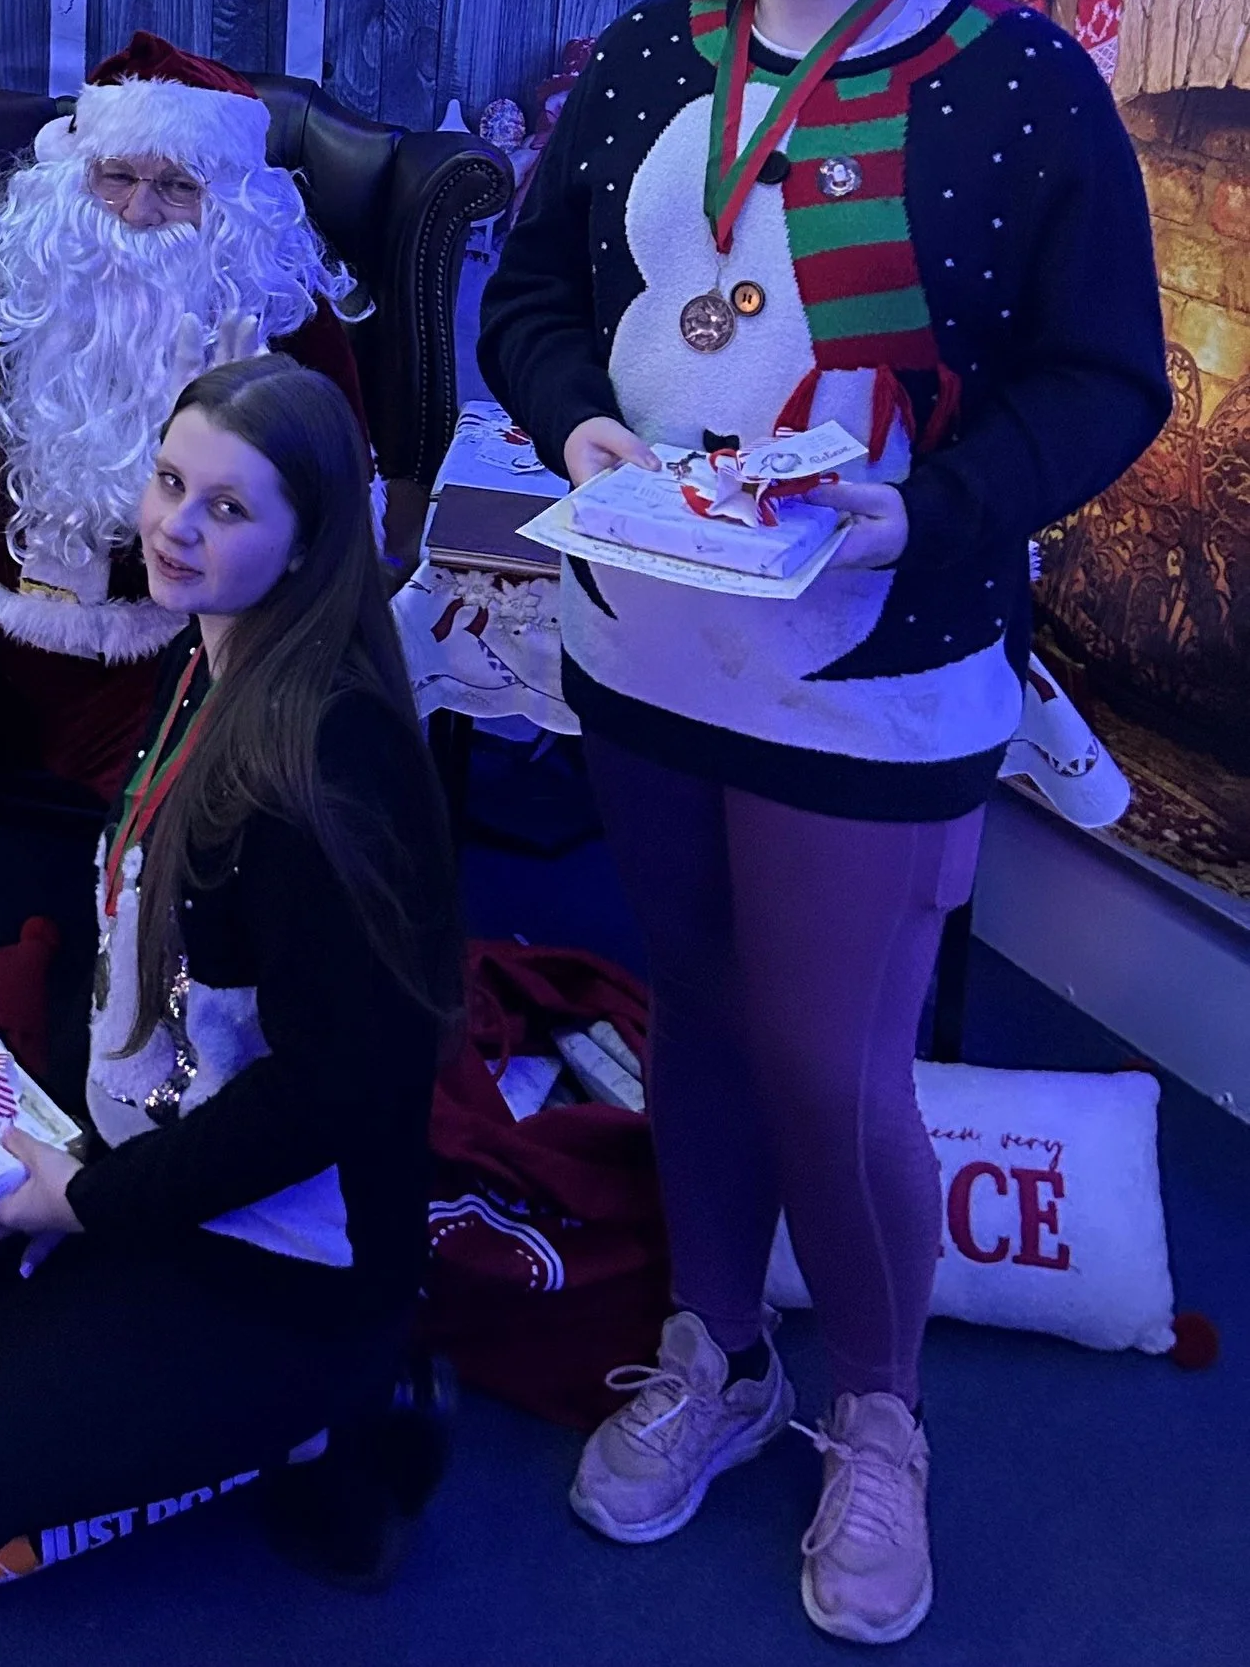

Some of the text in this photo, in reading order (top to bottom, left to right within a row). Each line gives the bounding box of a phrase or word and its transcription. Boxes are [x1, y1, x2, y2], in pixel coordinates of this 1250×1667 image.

[927, 1125, 1066, 1171] een very
[40, 1506, 139, 1567] JUST
